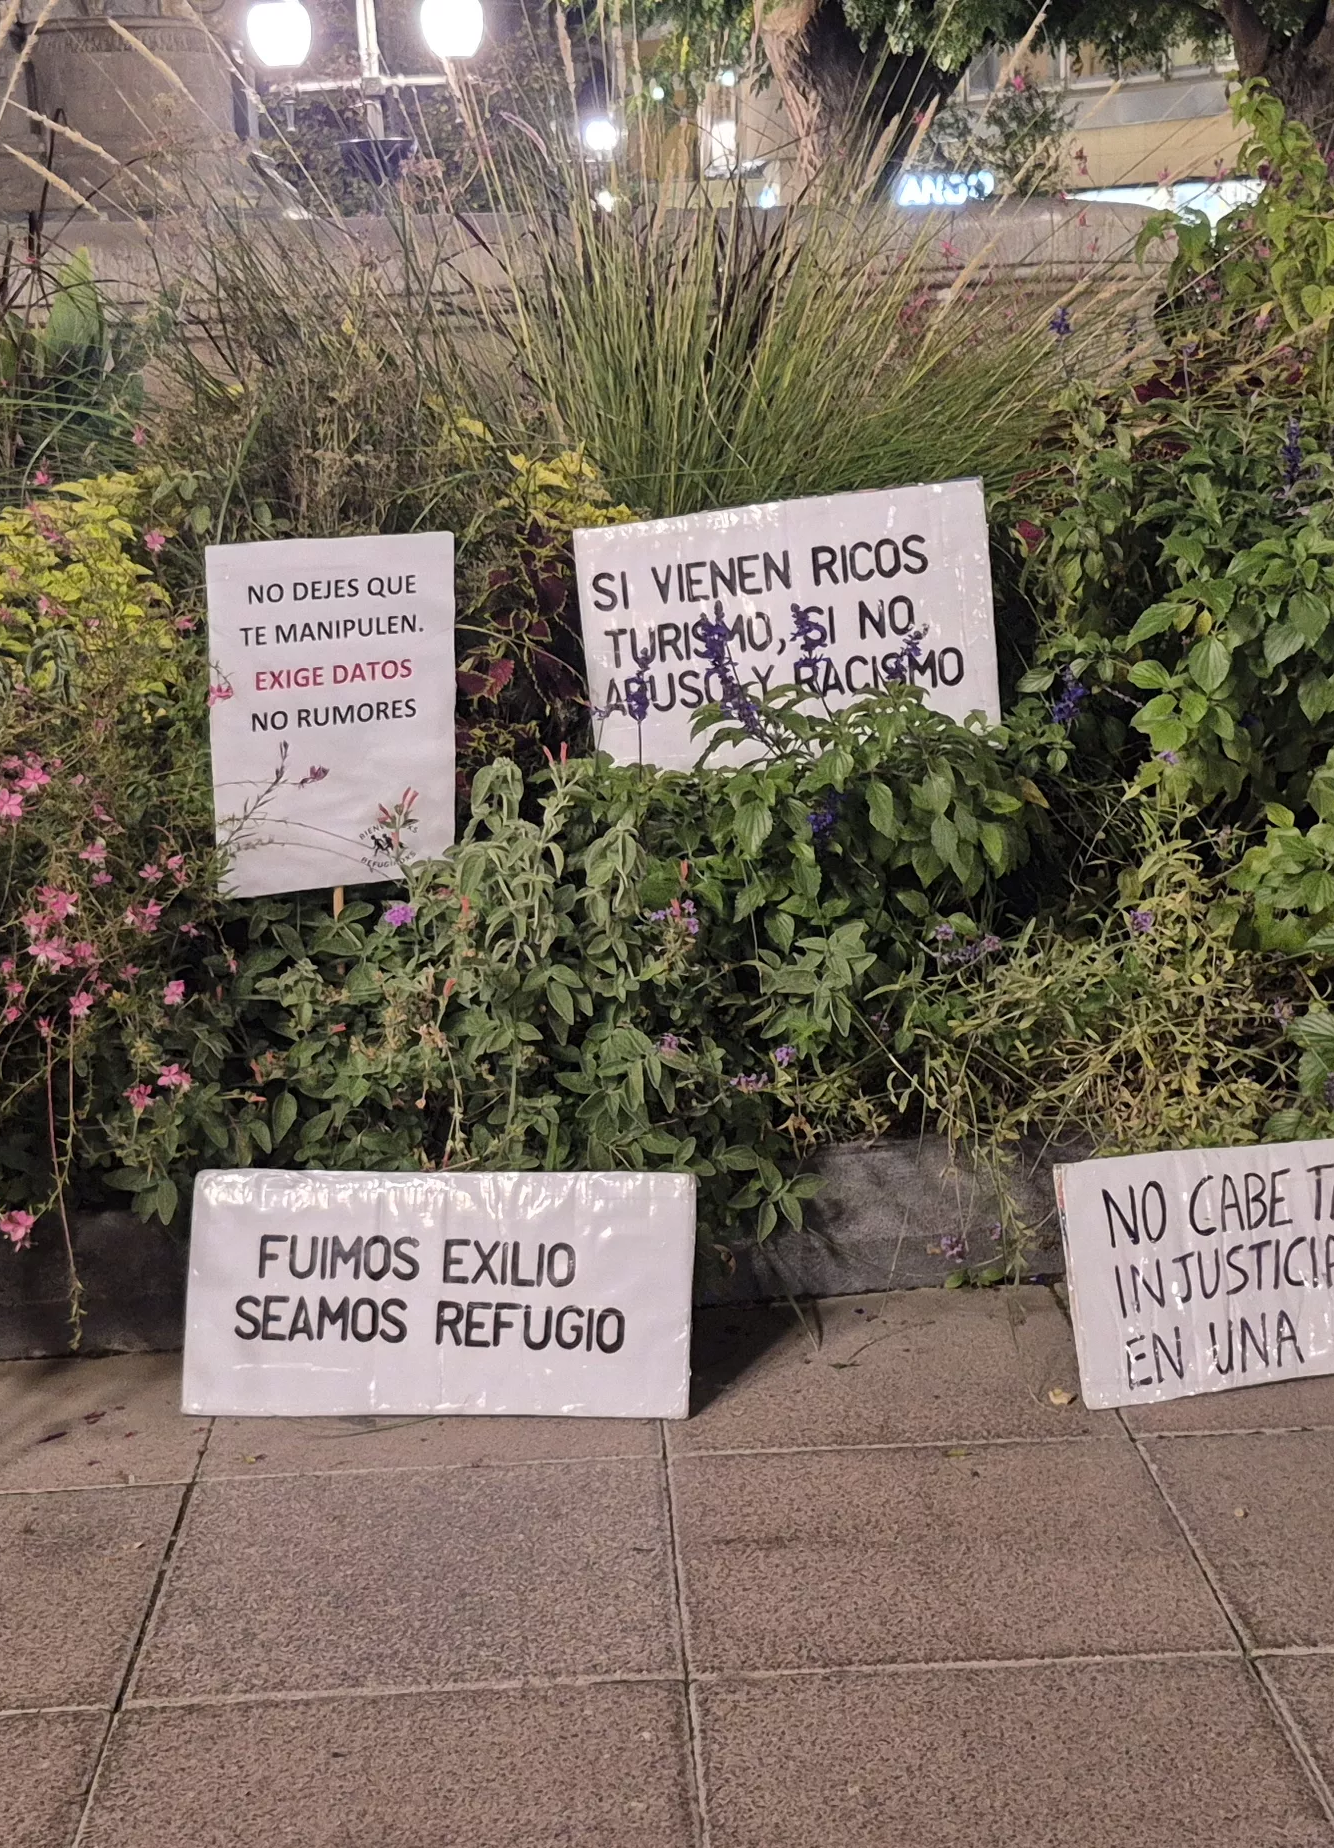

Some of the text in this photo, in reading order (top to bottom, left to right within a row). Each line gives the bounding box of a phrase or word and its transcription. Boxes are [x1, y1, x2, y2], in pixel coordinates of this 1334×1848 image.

[247, 574, 417, 605] NO DEJES QUE
[592, 534, 929, 612] SI VIENEN RICOS
[239, 614, 424, 646] TE MANIPULEN.
[858, 595, 915, 640] NO
[255, 658, 412, 691] EXIGE DATOS
[751, 664, 775, 688] Y
[251, 698, 417, 732] NO RUMORES
[1101, 1180, 1168, 1248] NO
[1189, 1167, 1293, 1236] CABE
[258, 1233, 577, 1288] FUIMOS EXILIO
[233, 1294, 627, 1354] SEAMOS REFUGIO
[1125, 1325, 1185, 1390] EN
[1210, 1309, 1305, 1376] UNA
